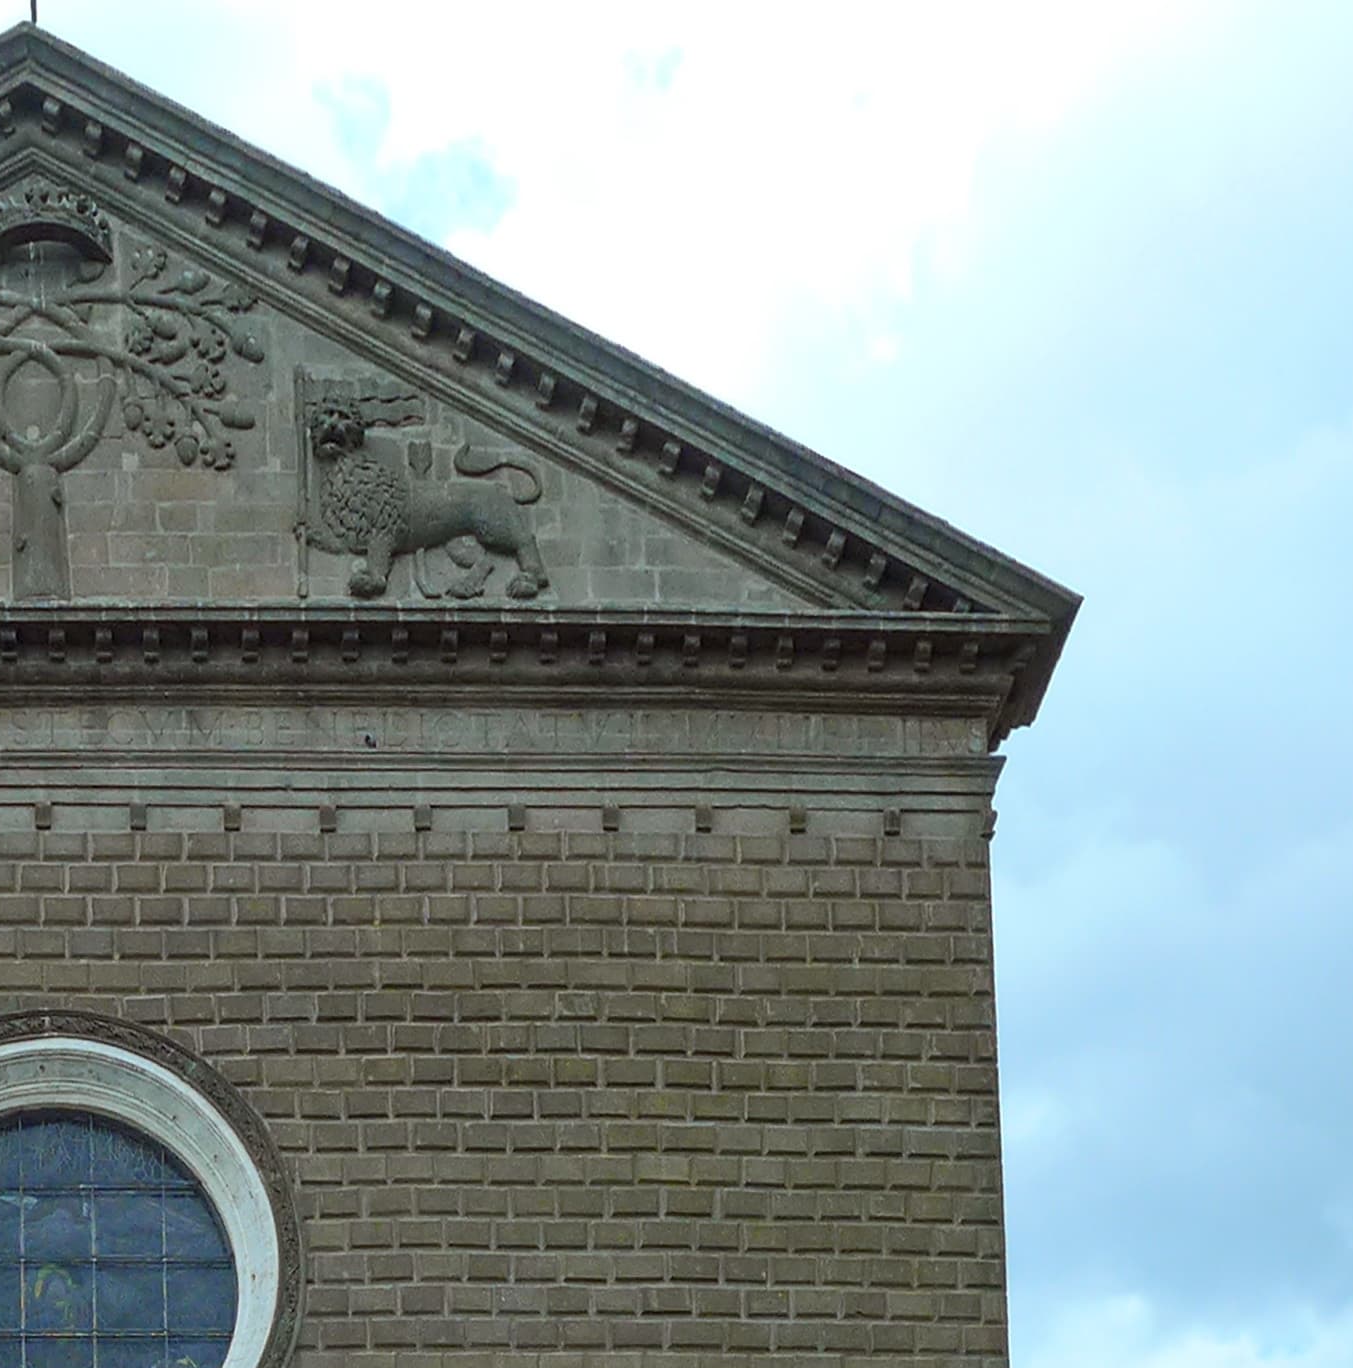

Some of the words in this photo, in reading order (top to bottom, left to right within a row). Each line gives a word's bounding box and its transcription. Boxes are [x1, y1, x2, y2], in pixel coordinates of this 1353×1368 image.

[37, 709, 224, 746] TECVM
[245, 709, 537, 748] BENEDICTA
[542, 711, 614, 748] TV
